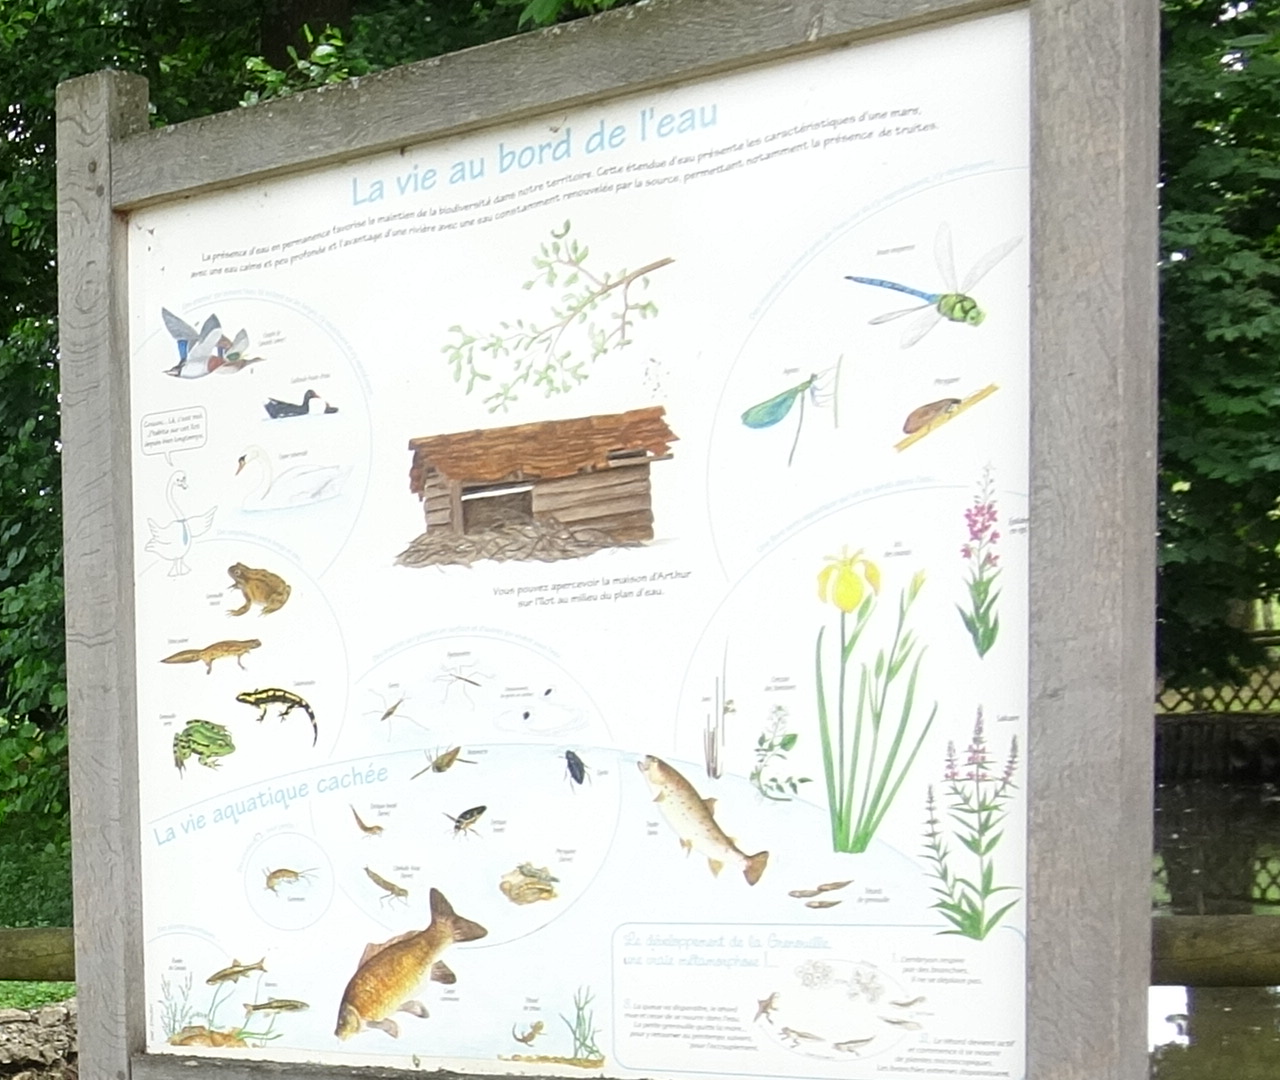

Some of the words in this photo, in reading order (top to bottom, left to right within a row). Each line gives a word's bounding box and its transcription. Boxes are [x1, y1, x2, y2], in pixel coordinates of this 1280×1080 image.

[202, 254, 213, 263] La
[212, 250, 247, 263] présence
[249, 247, 272, 255] d'eau
[282, 230, 330, 252] permanence
[333, 221, 366, 234] favorise
[378, 212, 415, 223] maintien
[430, 208, 437, 216] la
[439, 197, 491, 215] biodiversité
[493, 192, 516, 204] dans
[518, 184, 543, 196] notre
[597, 166, 623, 176] Cette
[626, 160, 666, 172] étendue
[669, 156, 695, 166] d'eau
[698, 143, 744, 163] présente
[747, 138, 761, 147] les
[764, 116, 856, 142] caractéristiques
[859, 112, 888, 122] d'une
[351, 176, 385, 207] La
[394, 162, 436, 197] vie
[448, 157, 486, 186] au
[496, 127, 572, 174] bord
[583, 119, 626, 155] de
[639, 102, 718, 142] l'eau
[385, 229, 407, 238] d'une
[409, 226, 436, 234] rivière
[438, 223, 457, 231] avec
[460, 219, 475, 228] une
[477, 216, 493, 224] eau
[495, 195, 560, 220] constamment
[563, 184, 613, 199] renouvelée
[616, 182, 632, 193] par
[635, 179, 643, 188] la
[684, 160, 743, 183] permettant
[746, 142, 808, 165] notamment
[812, 139, 820, 148] la
[824, 132, 873, 148] présence
[878, 128, 892, 137] de
[517, 585, 548, 596] pouvez
[551, 580, 600, 593] apercevoir
[613, 576, 647, 584] maison
[649, 571, 691, 581] d'Arthur
[571, 593, 597, 602] milieu
[600, 592, 611, 600] du
[614, 590, 633, 601] plan
[153, 824, 177, 846] La
[181, 813, 207, 835] vie
[212, 783, 310, 825] aquatique
[317, 762, 389, 794] cachée
